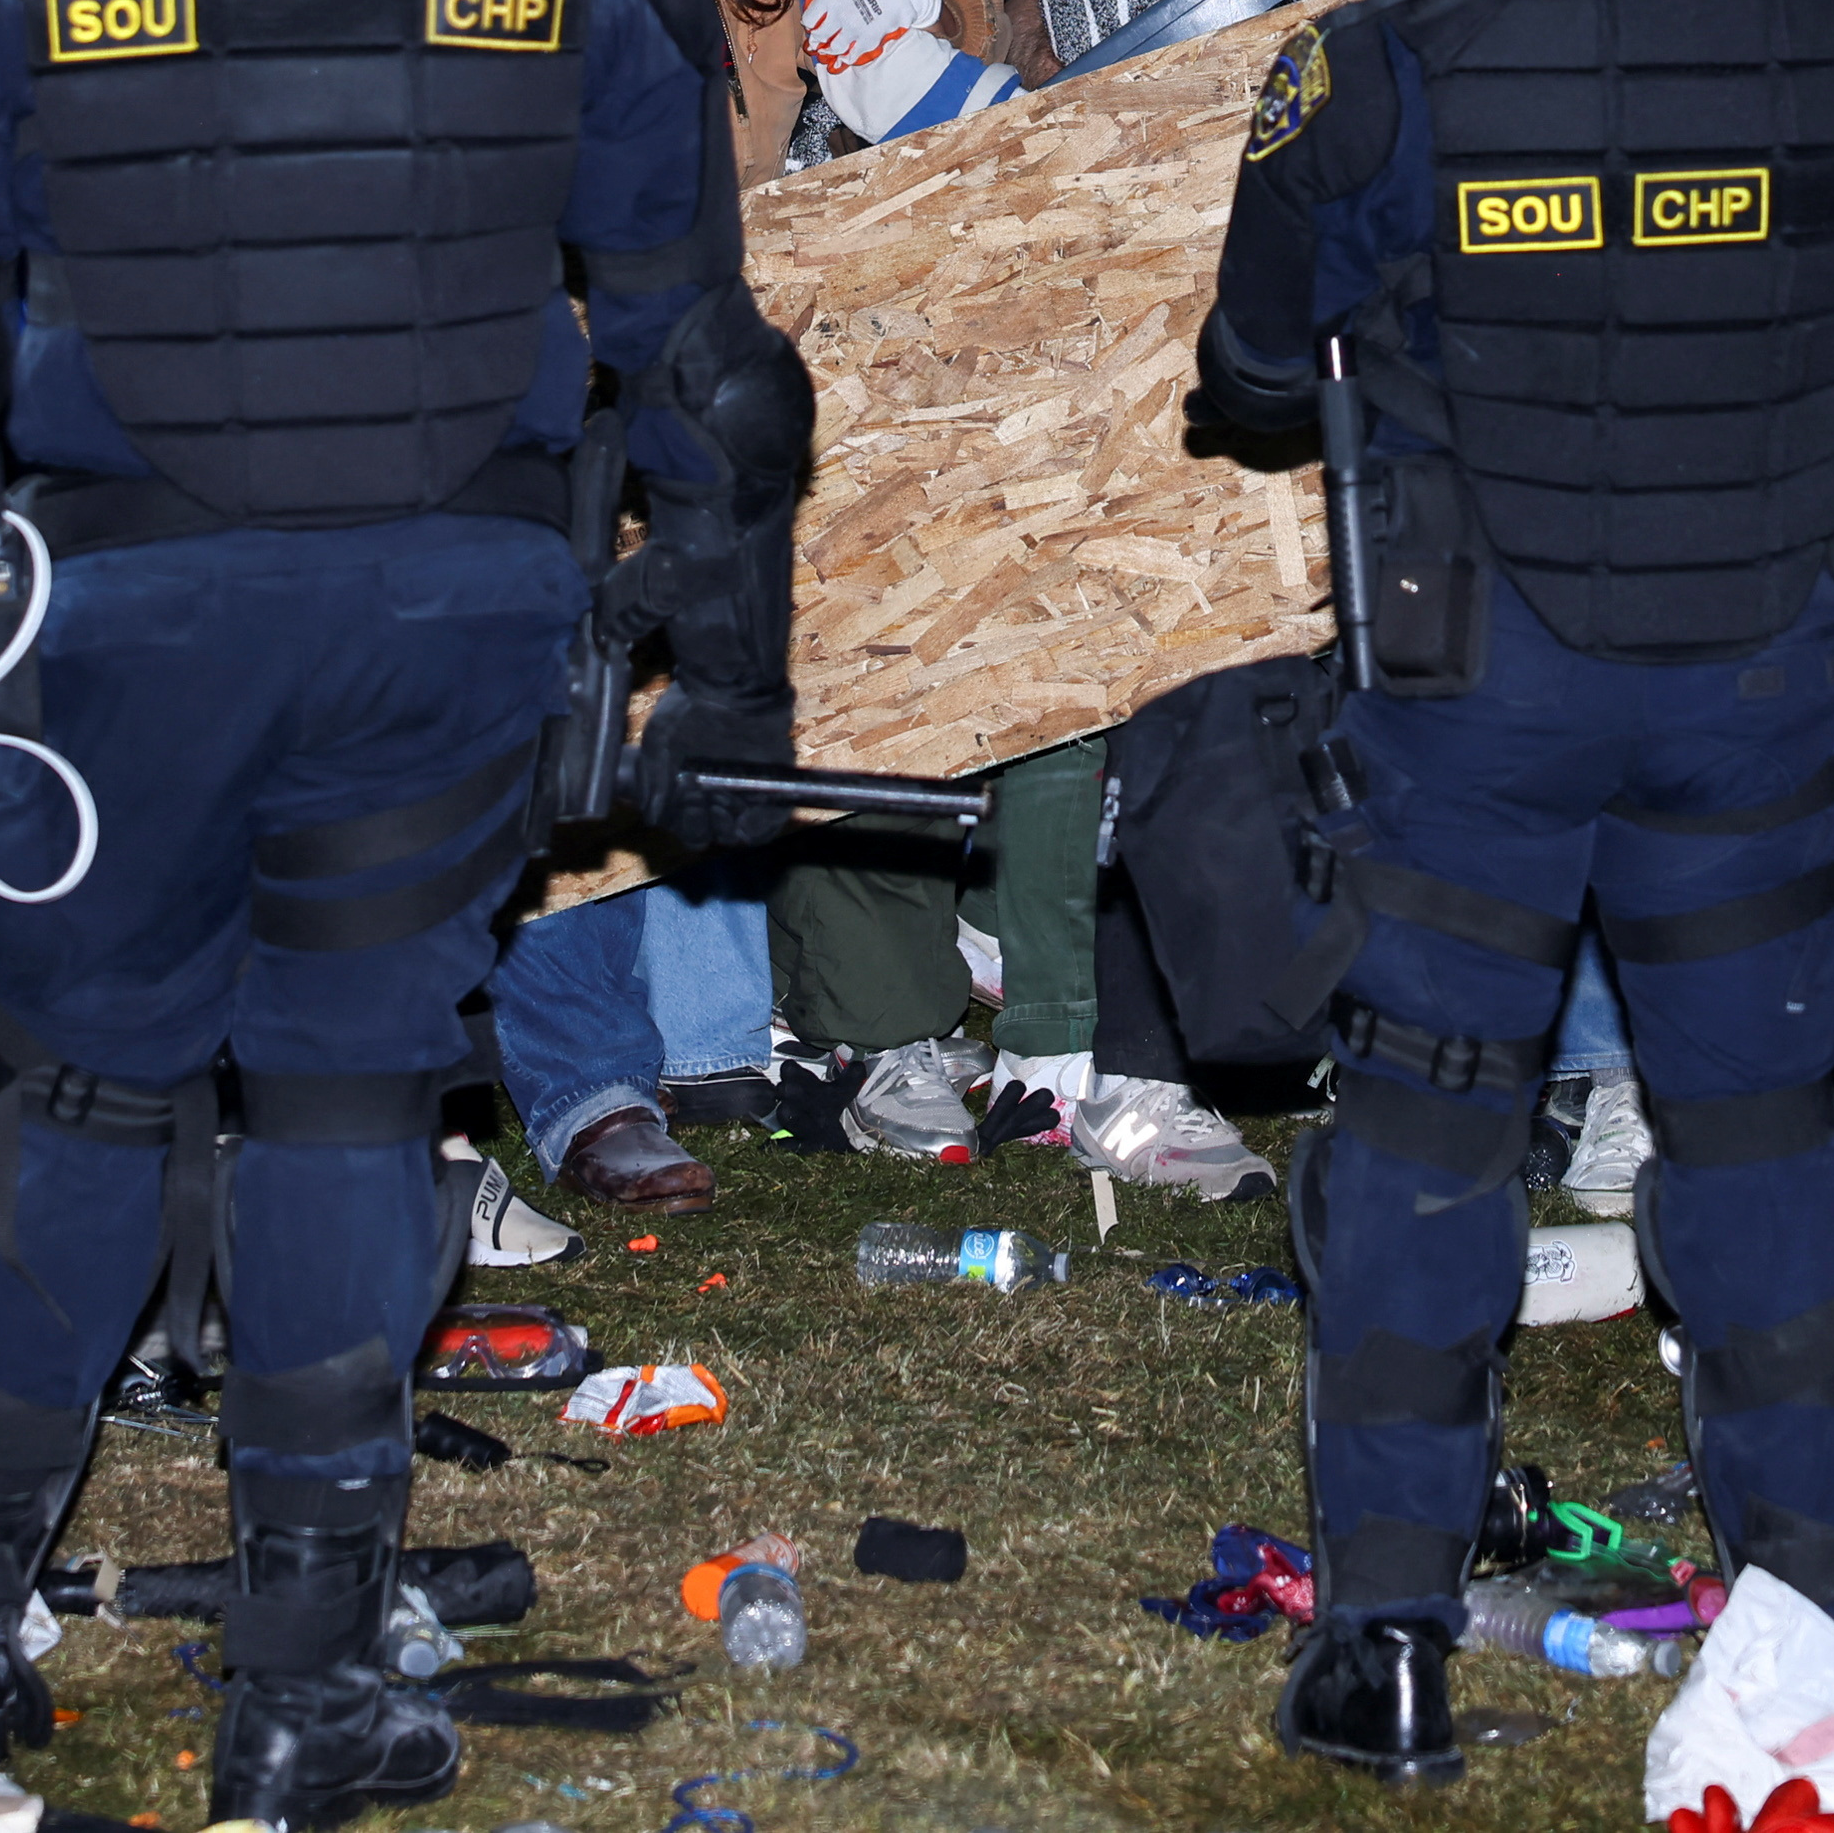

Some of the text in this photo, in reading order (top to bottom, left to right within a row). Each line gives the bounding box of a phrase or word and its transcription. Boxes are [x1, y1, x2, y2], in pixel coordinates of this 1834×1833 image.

[1477, 186, 1753, 236] SOU CHP
[1103, 1110, 1159, 1161] N
